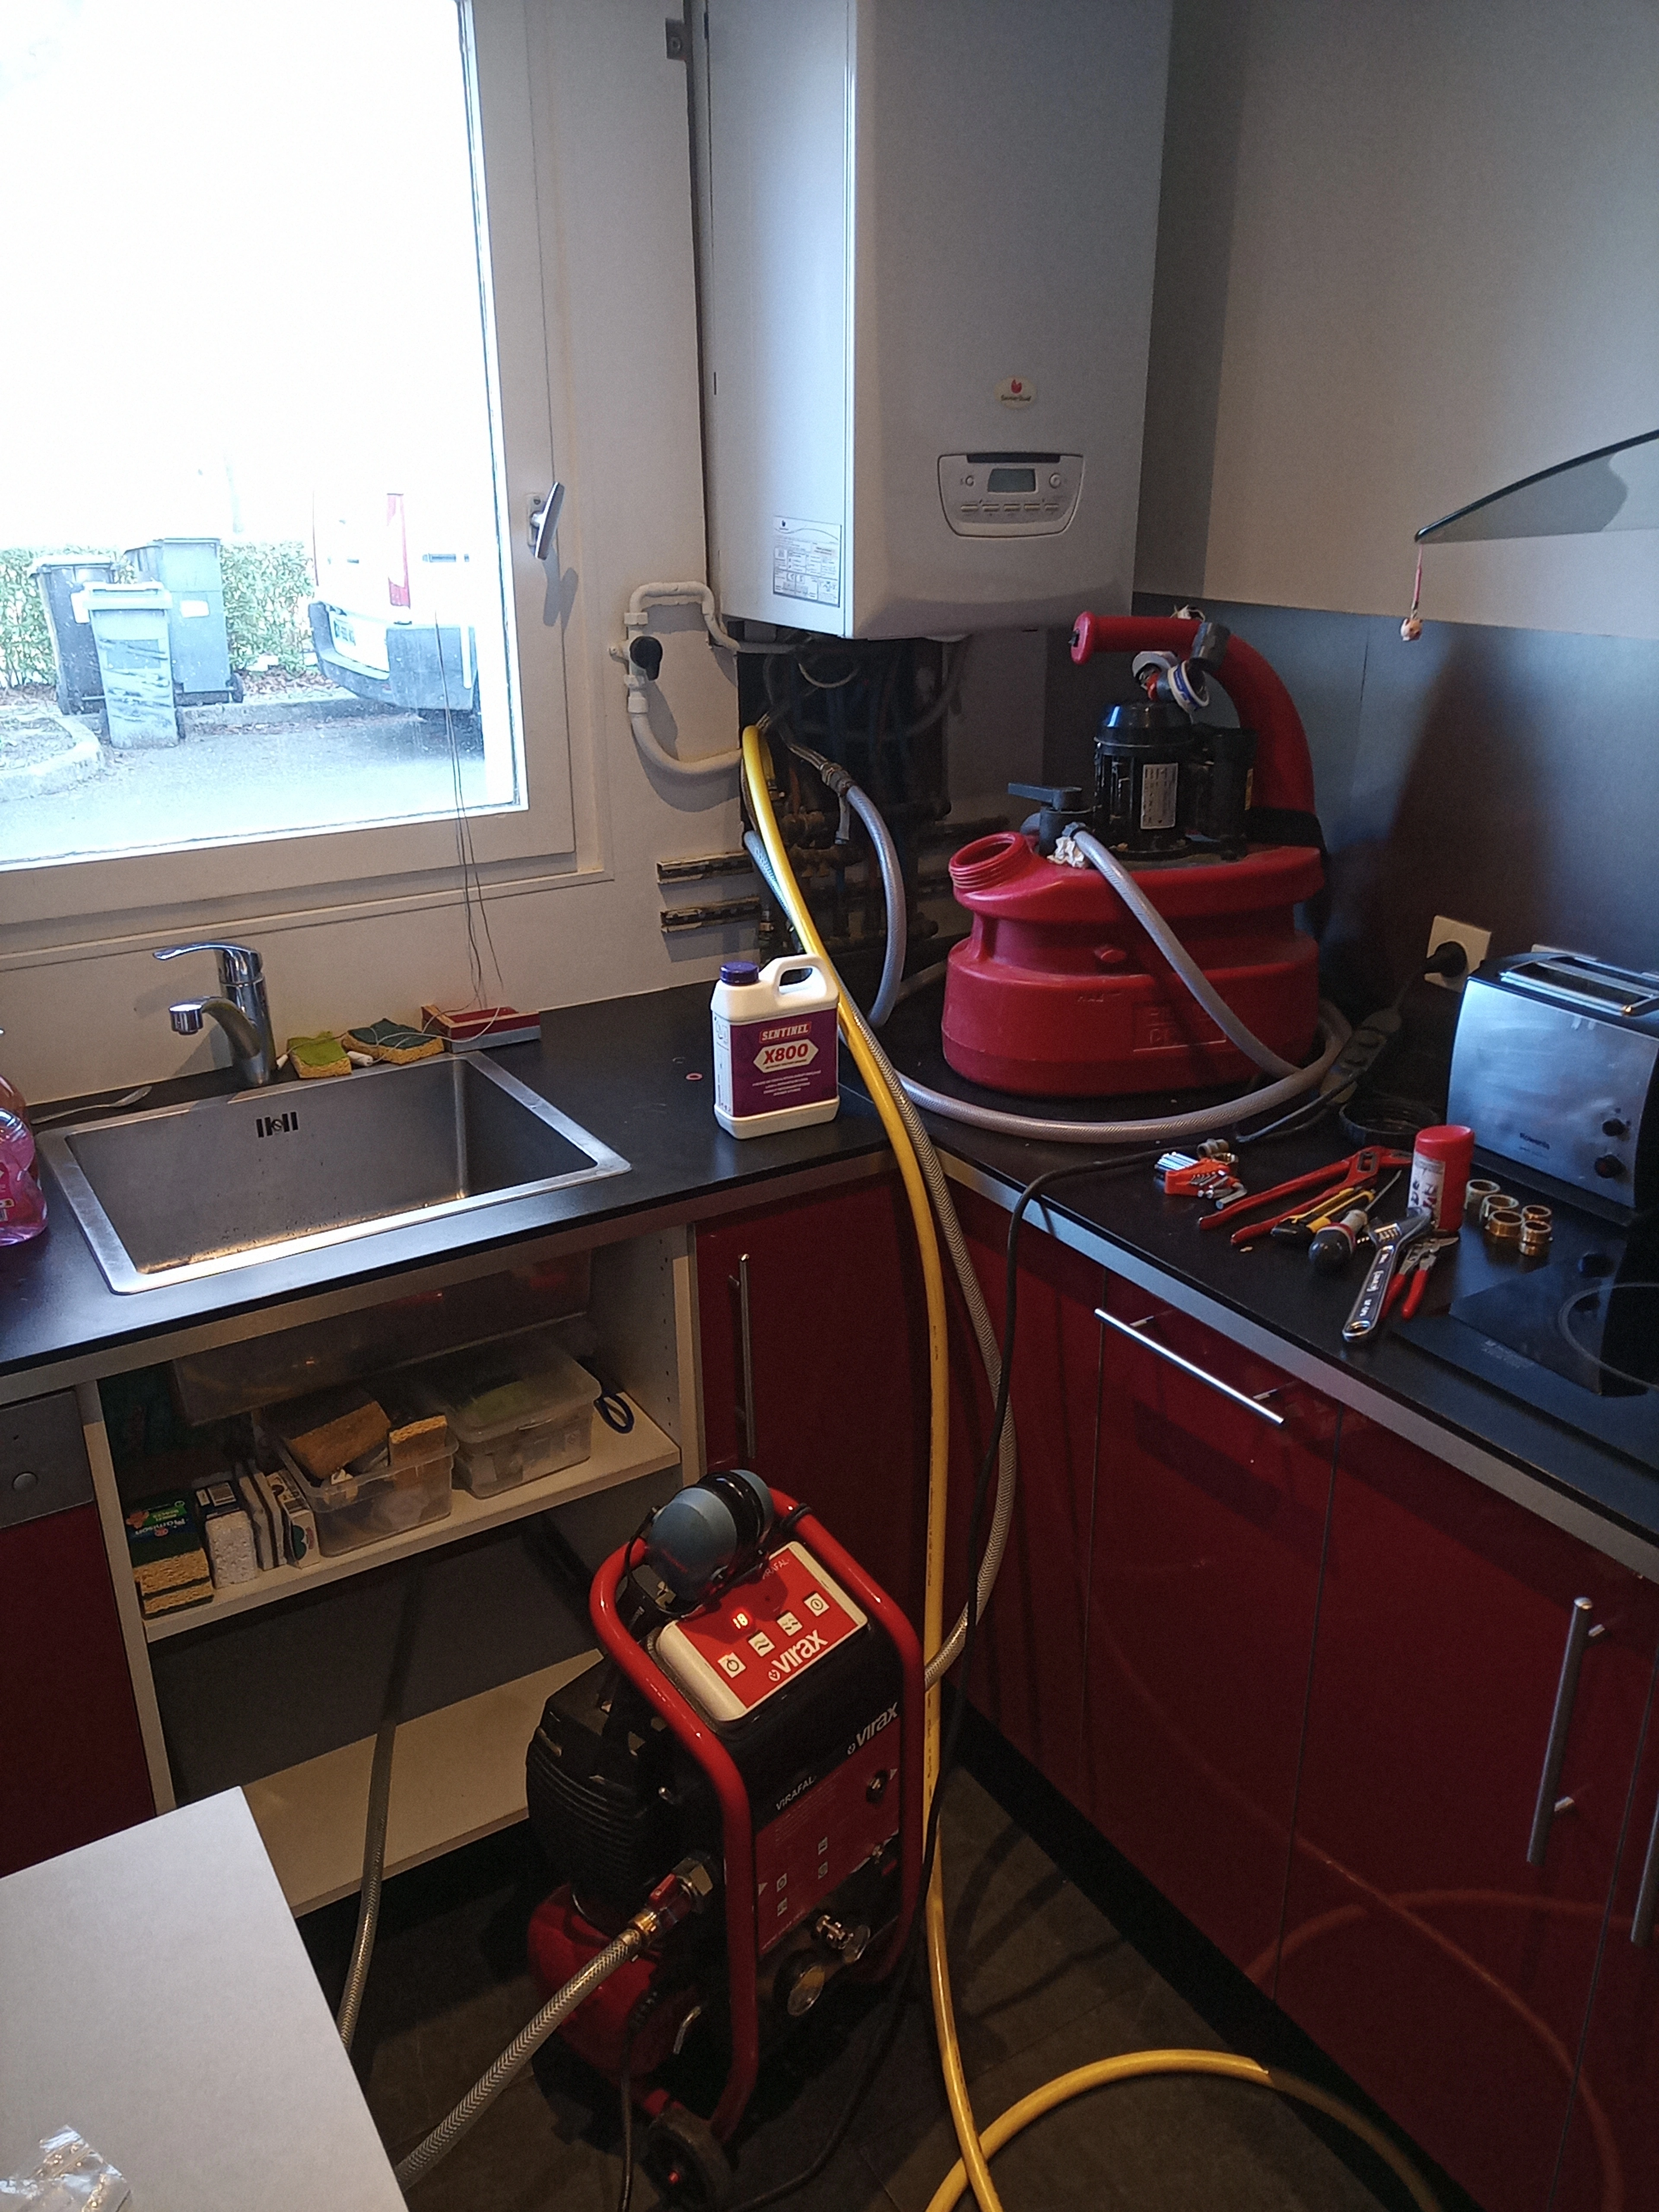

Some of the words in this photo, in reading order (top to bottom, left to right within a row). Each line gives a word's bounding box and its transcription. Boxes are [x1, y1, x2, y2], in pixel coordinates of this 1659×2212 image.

[762, 1023, 809, 1040] SENTINEL
[763, 1043, 808, 1065] X800
[771, 1630, 828, 1674] virax
[856, 1702, 898, 1747] virax
[775, 1776, 816, 1811] VIRAFAL
